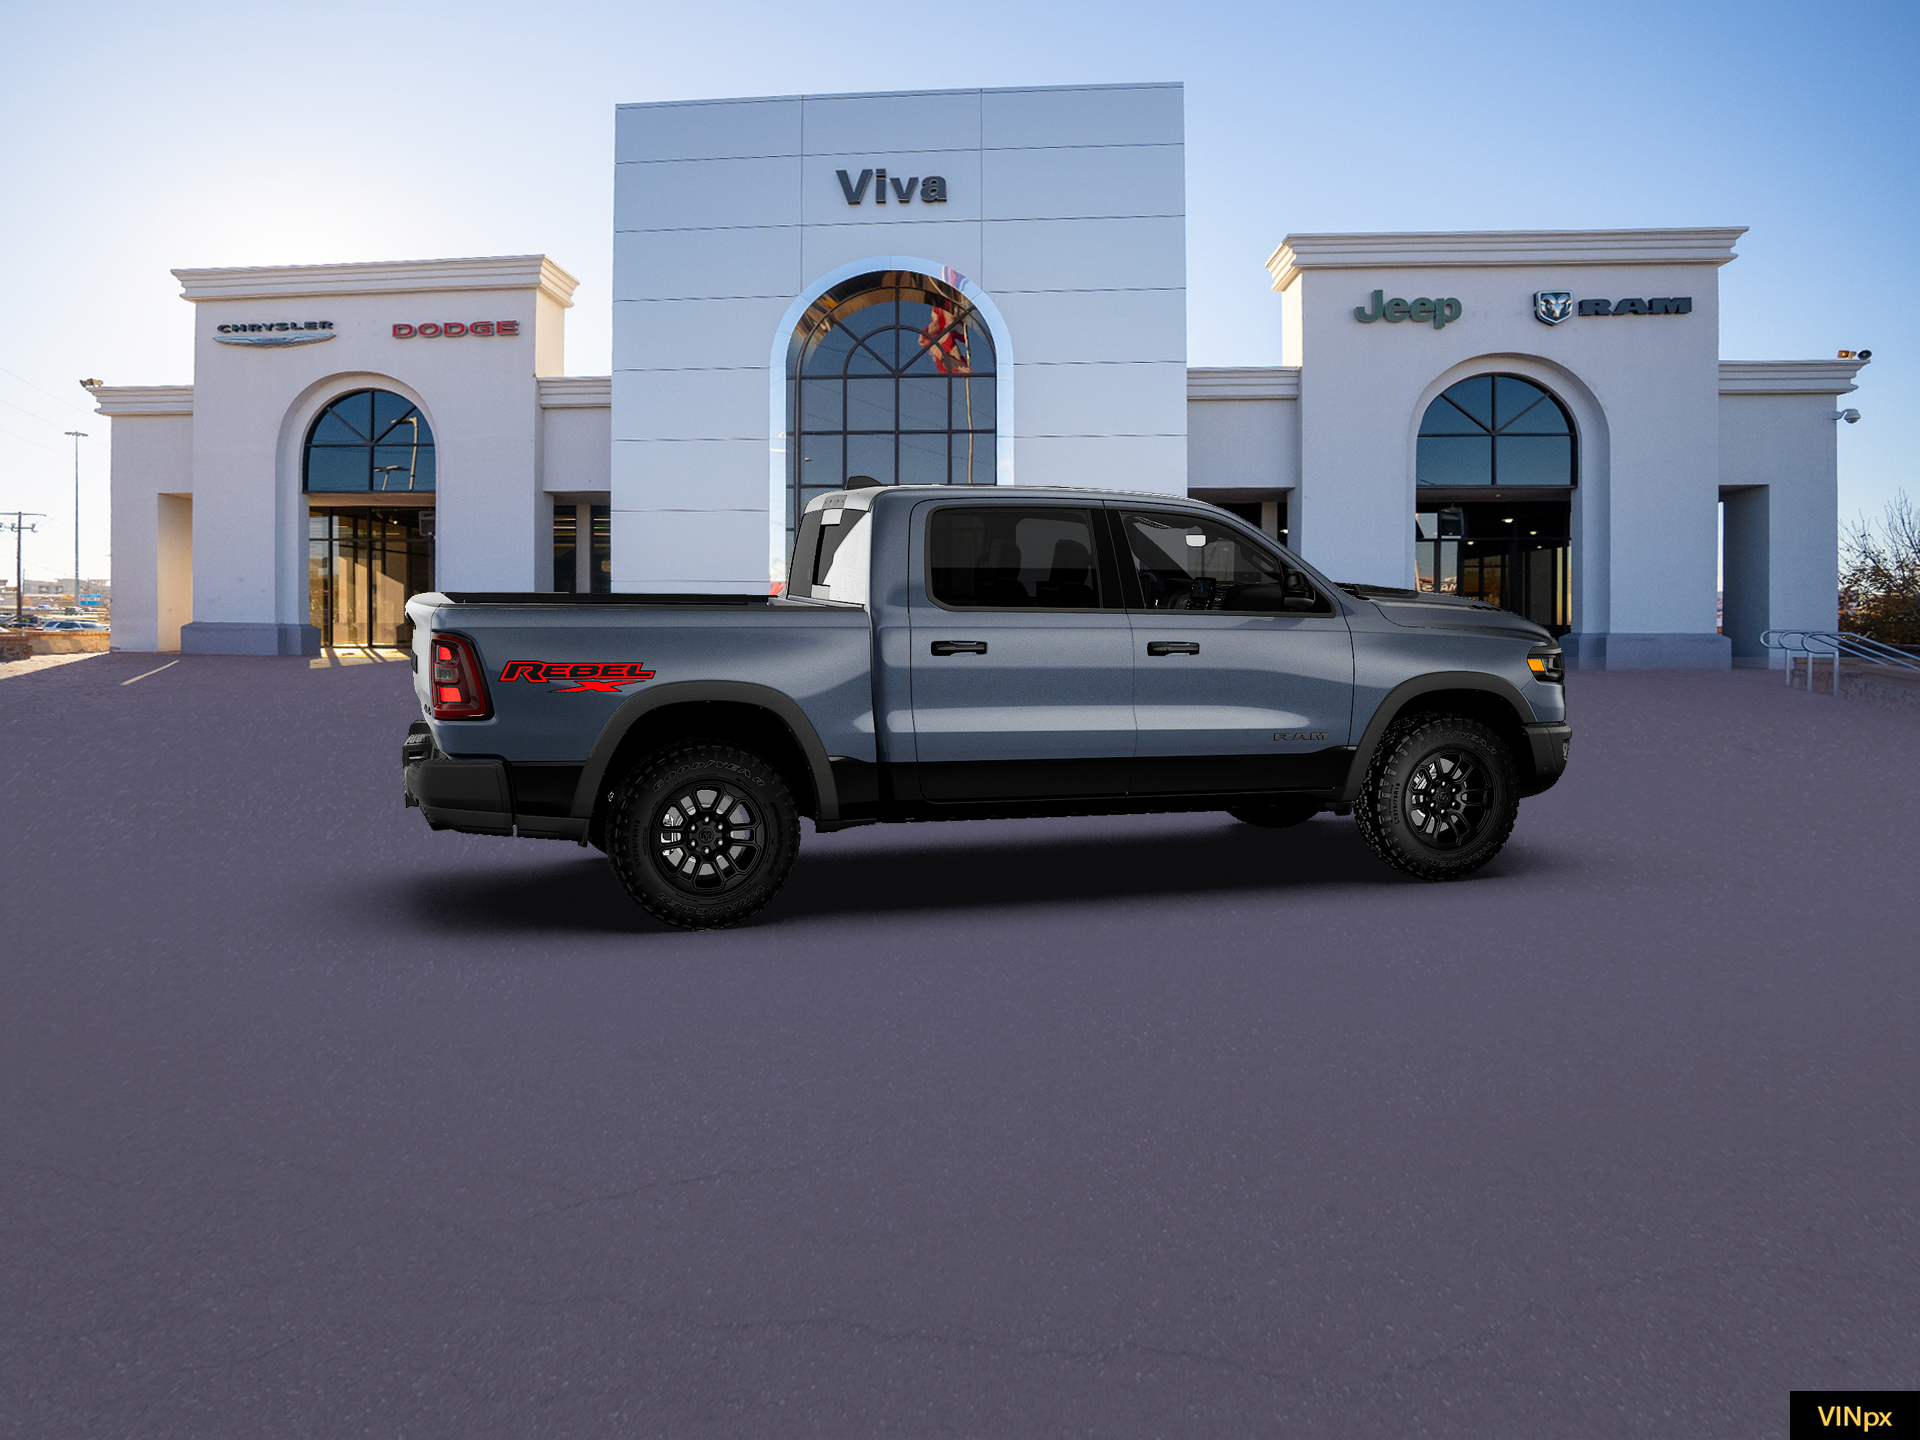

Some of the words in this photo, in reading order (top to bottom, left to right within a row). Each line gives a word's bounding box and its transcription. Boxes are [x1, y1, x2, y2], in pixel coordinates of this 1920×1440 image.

[835, 168, 948, 205] Viva
[1354, 289, 1463, 329] Jeep
[1578, 297, 1693, 317] RAM
[216, 320, 334, 334] CHRYSLER
[392, 320, 521, 339] DODGE
[498, 660, 656, 683] REBEL
[1273, 731, 1329, 741] RAM
